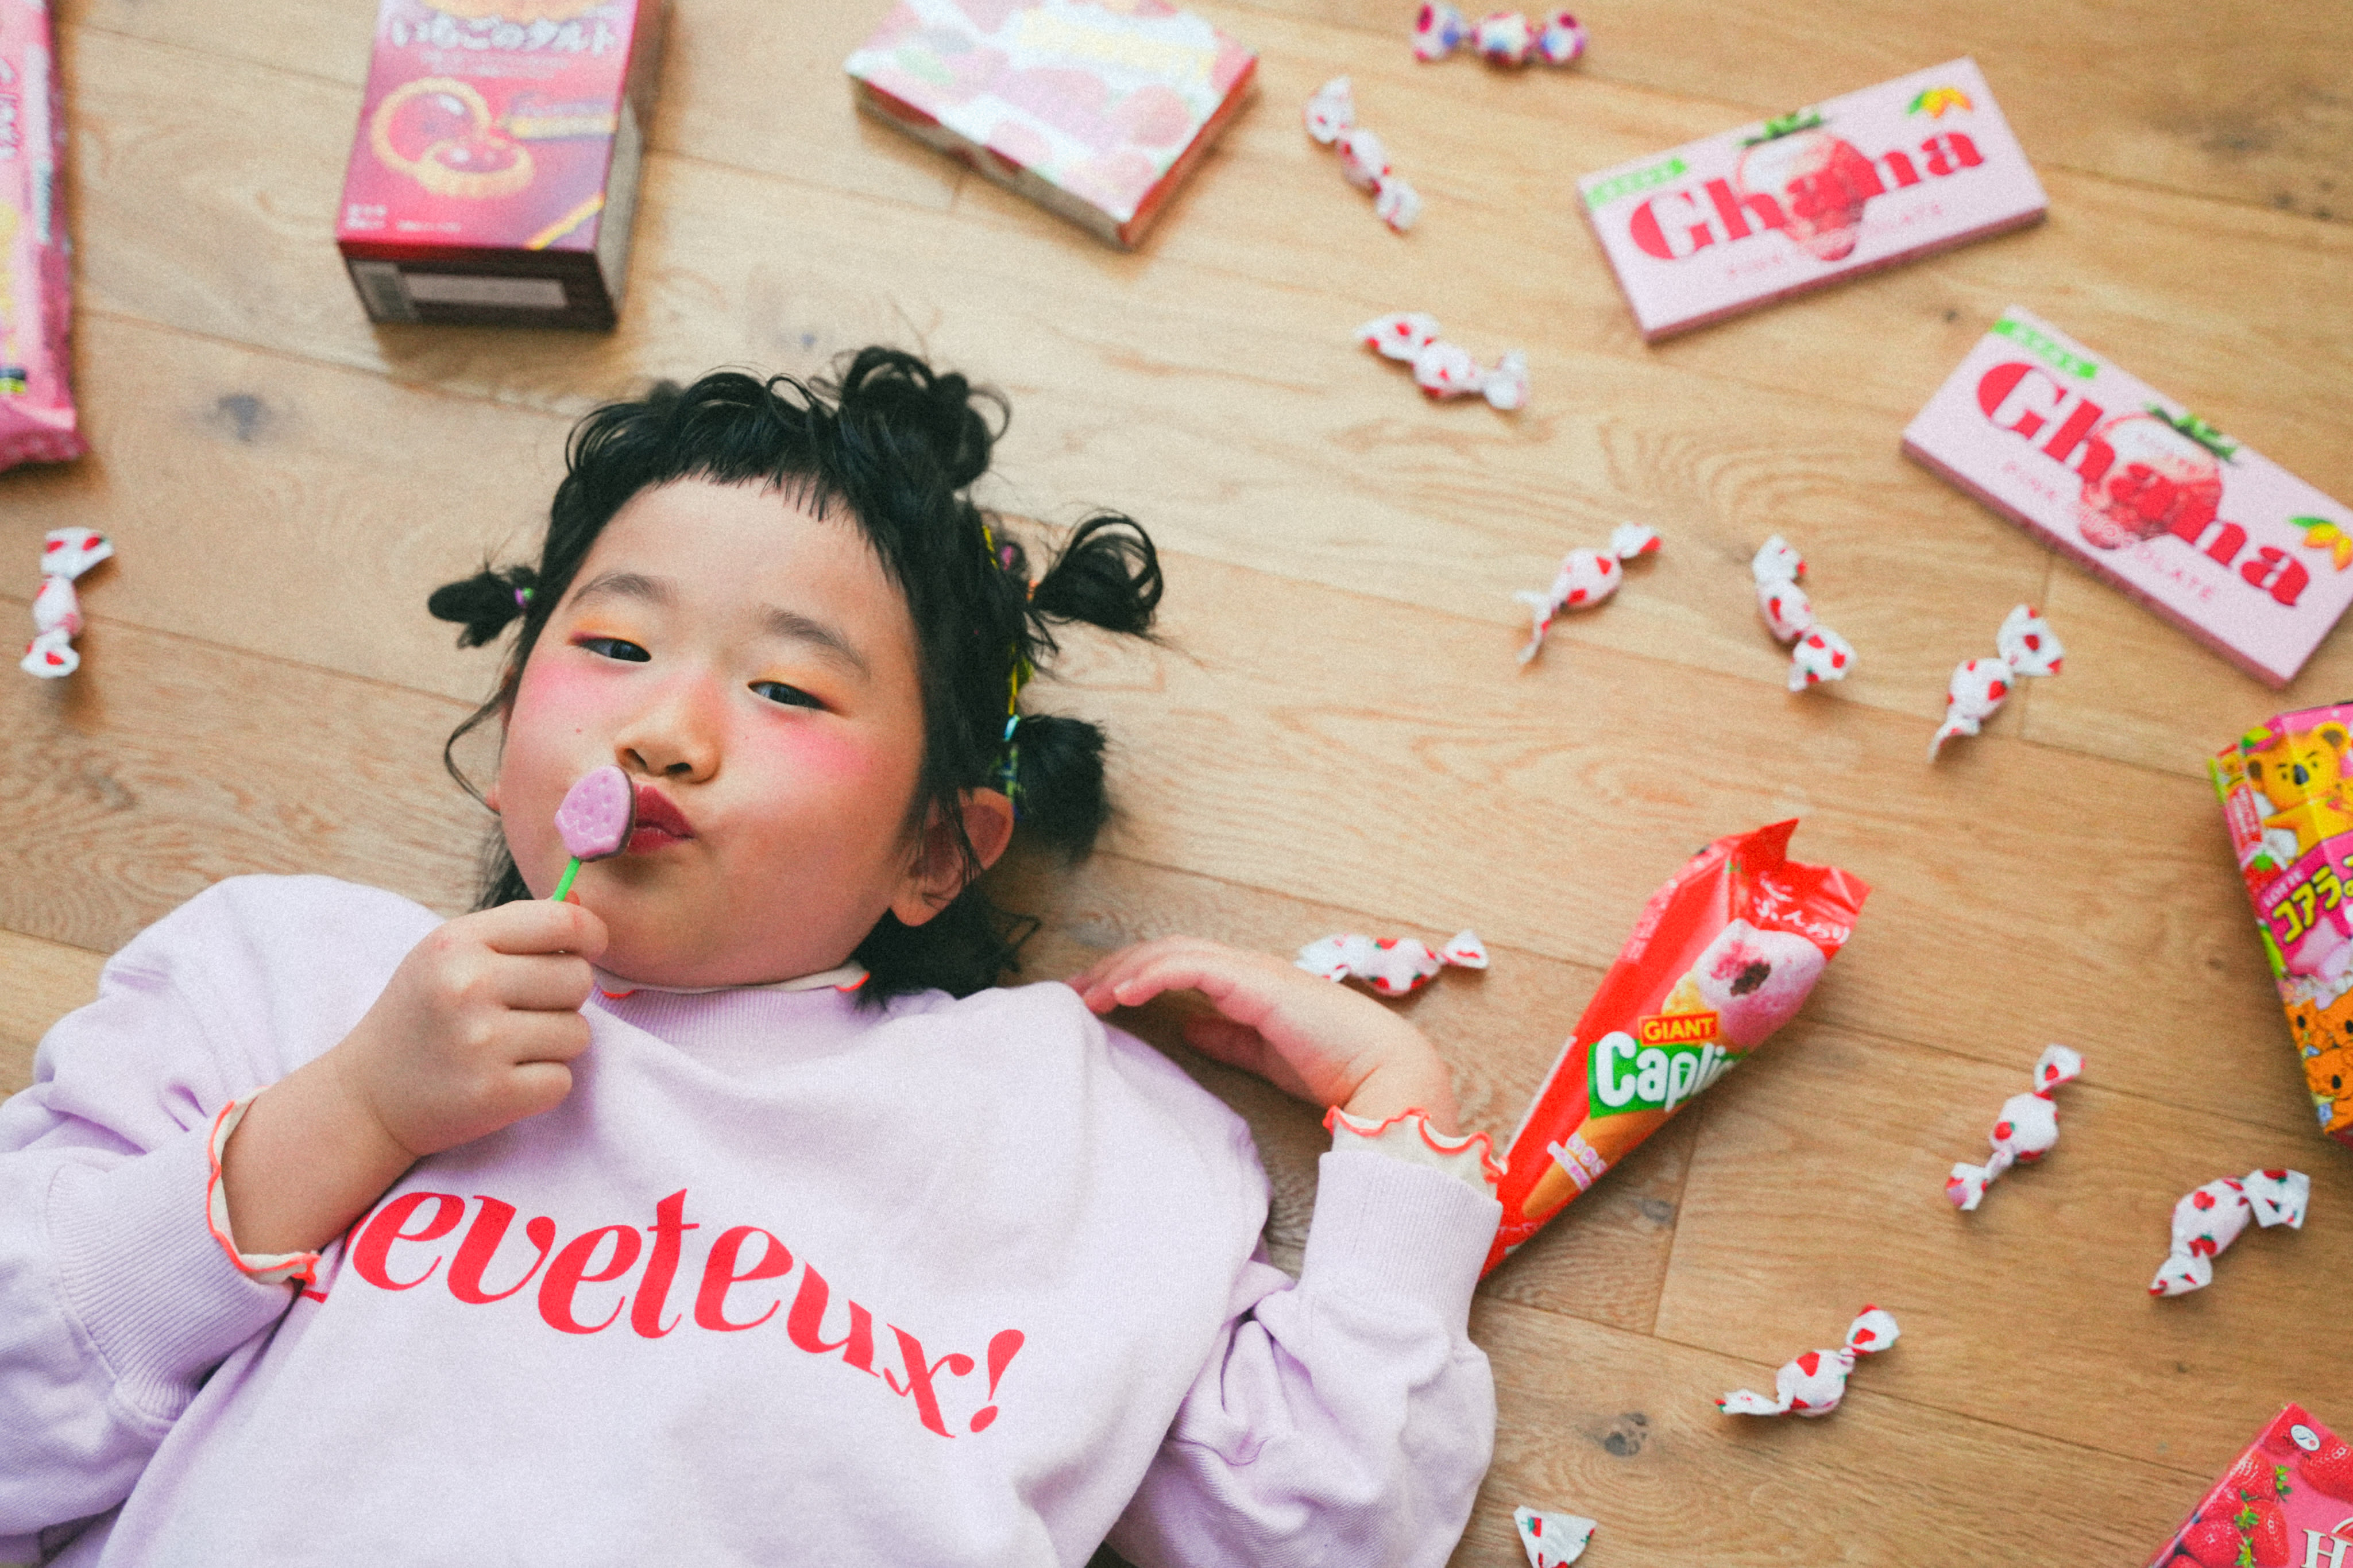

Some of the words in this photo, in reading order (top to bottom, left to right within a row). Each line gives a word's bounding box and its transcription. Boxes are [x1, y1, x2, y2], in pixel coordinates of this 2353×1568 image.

[1630, 131, 1985, 260] Ghana
[1977, 362, 2310, 607] Ghana
[1644, 1017, 1714, 1041] GIANT
[299, 1188, 1025, 1439] eveteux!
